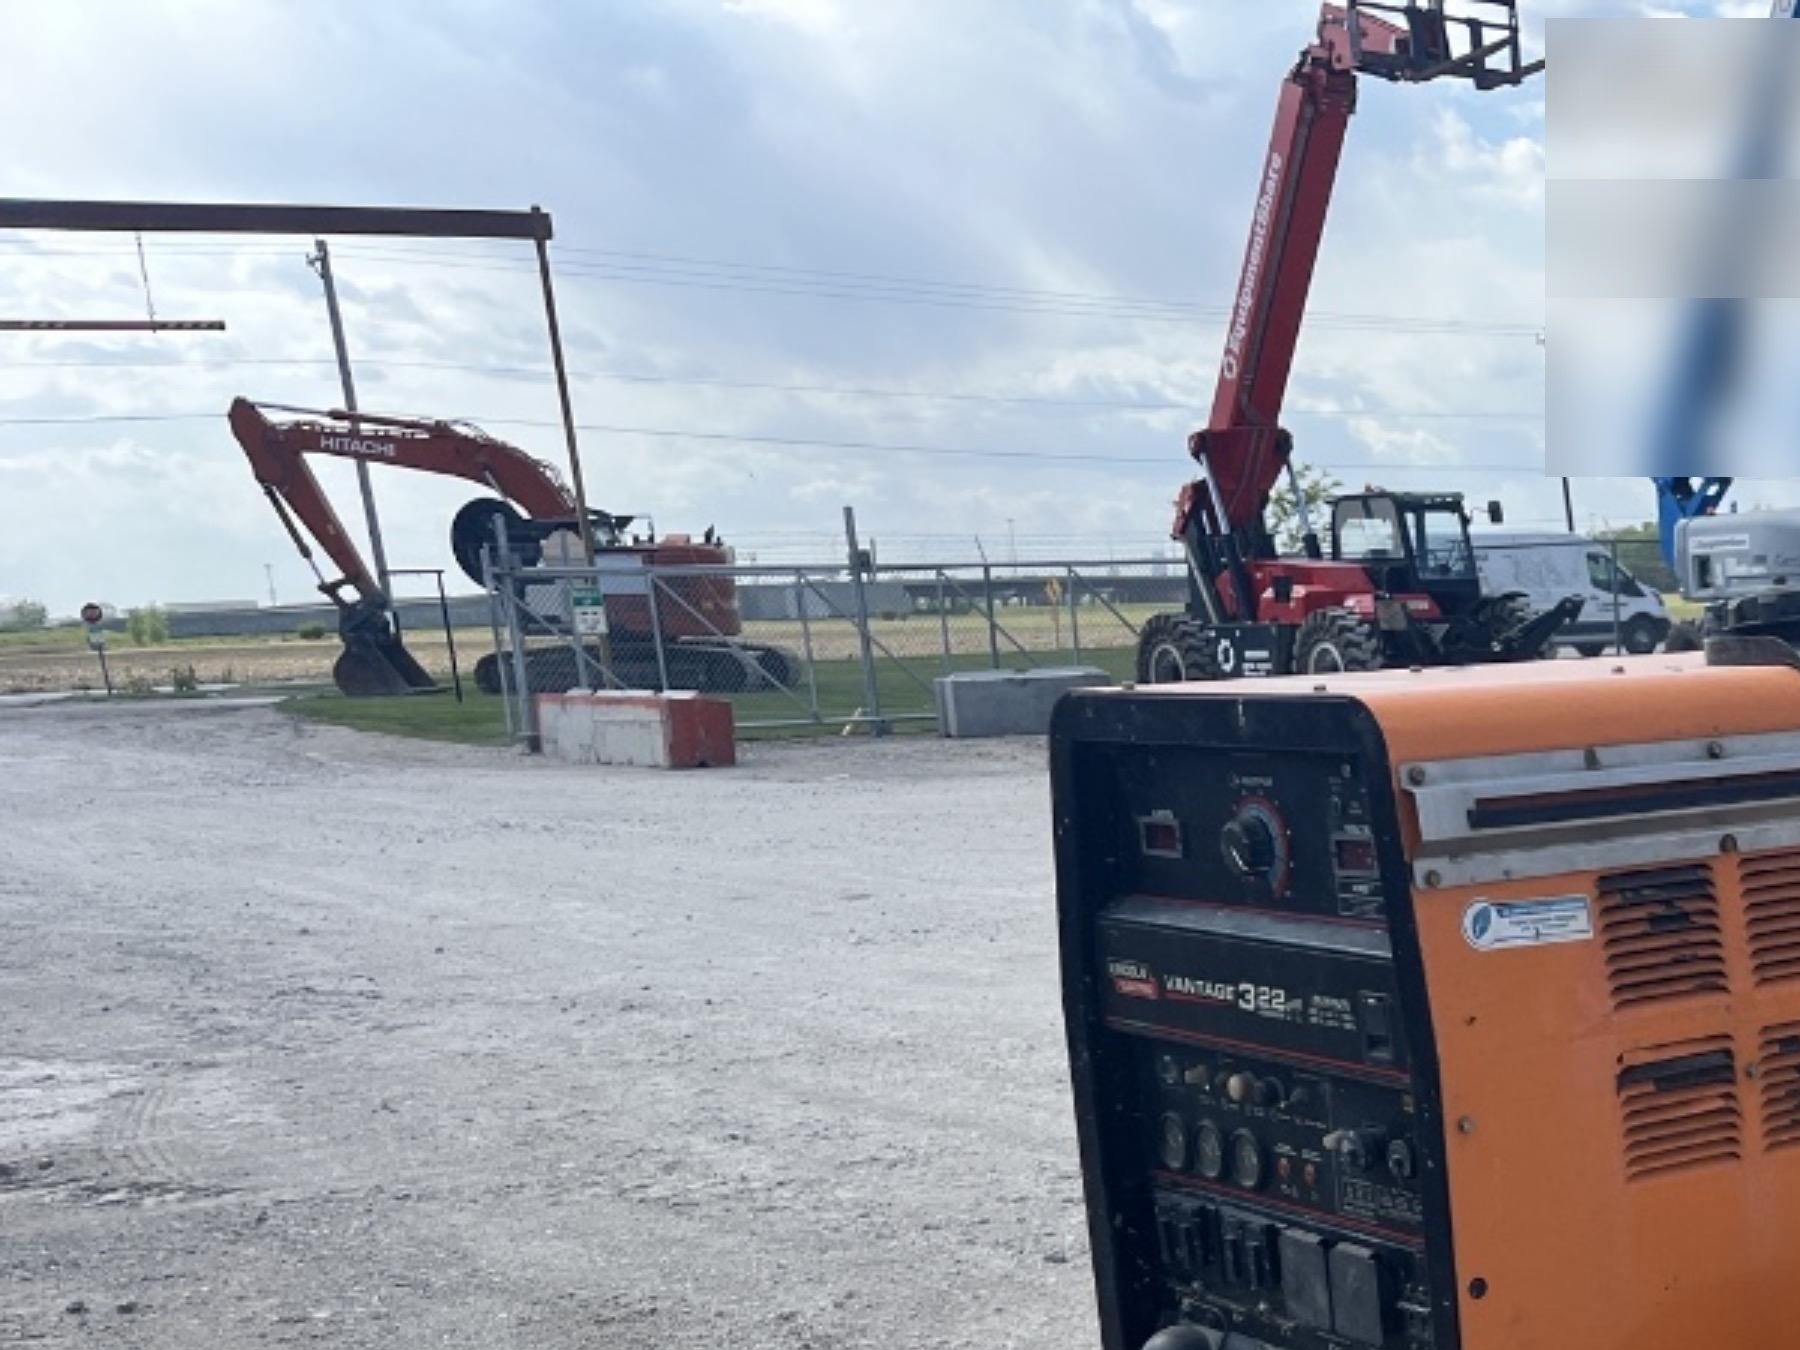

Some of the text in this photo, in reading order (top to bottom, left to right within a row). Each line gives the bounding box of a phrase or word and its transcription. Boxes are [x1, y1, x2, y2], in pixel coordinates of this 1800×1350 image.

[320, 434, 396, 457] HITACHI
[1164, 974, 1235, 1000] VANTAGE
[1237, 982, 1286, 1012] 322
